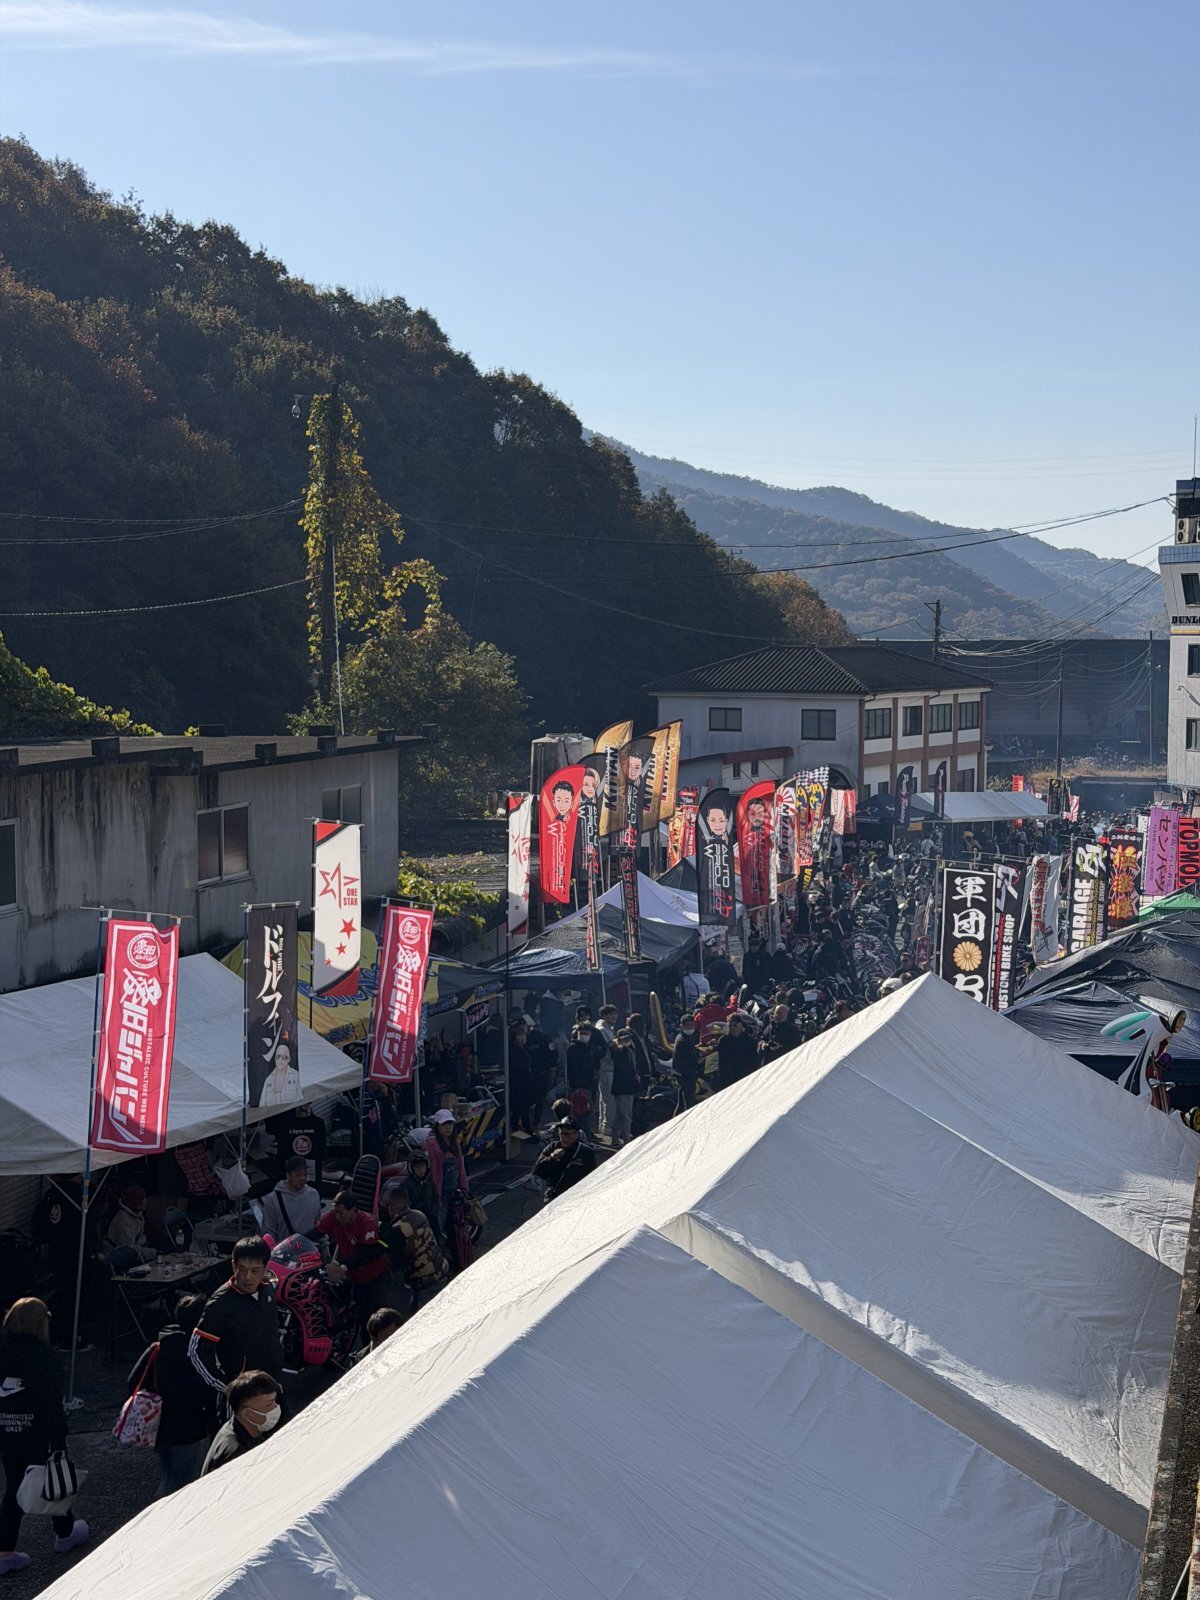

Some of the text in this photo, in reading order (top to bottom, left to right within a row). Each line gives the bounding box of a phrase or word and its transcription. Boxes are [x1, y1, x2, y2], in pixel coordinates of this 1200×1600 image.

[1171, 616, 1200, 624] DUNL
[721, 843, 730, 888] AUTO
[1154, 815, 1171, 892] センバツ
[1180, 818, 1199, 886] TOPMOD
[344, 898, 358, 906] STAR
[346, 888, 358, 896] ONE
[951, 876, 987, 942] 軍団
[1071, 878, 1095, 953] GARAGE
[256, 924, 284, 1062] ドルフィン
[998, 913, 1015, 1011] USTOM BIKE SHOP
[403, 1017, 411, 1040] CULTURE
[139, 1028, 153, 1135] NOSTALGIC CULTURE WEB MEDIA
